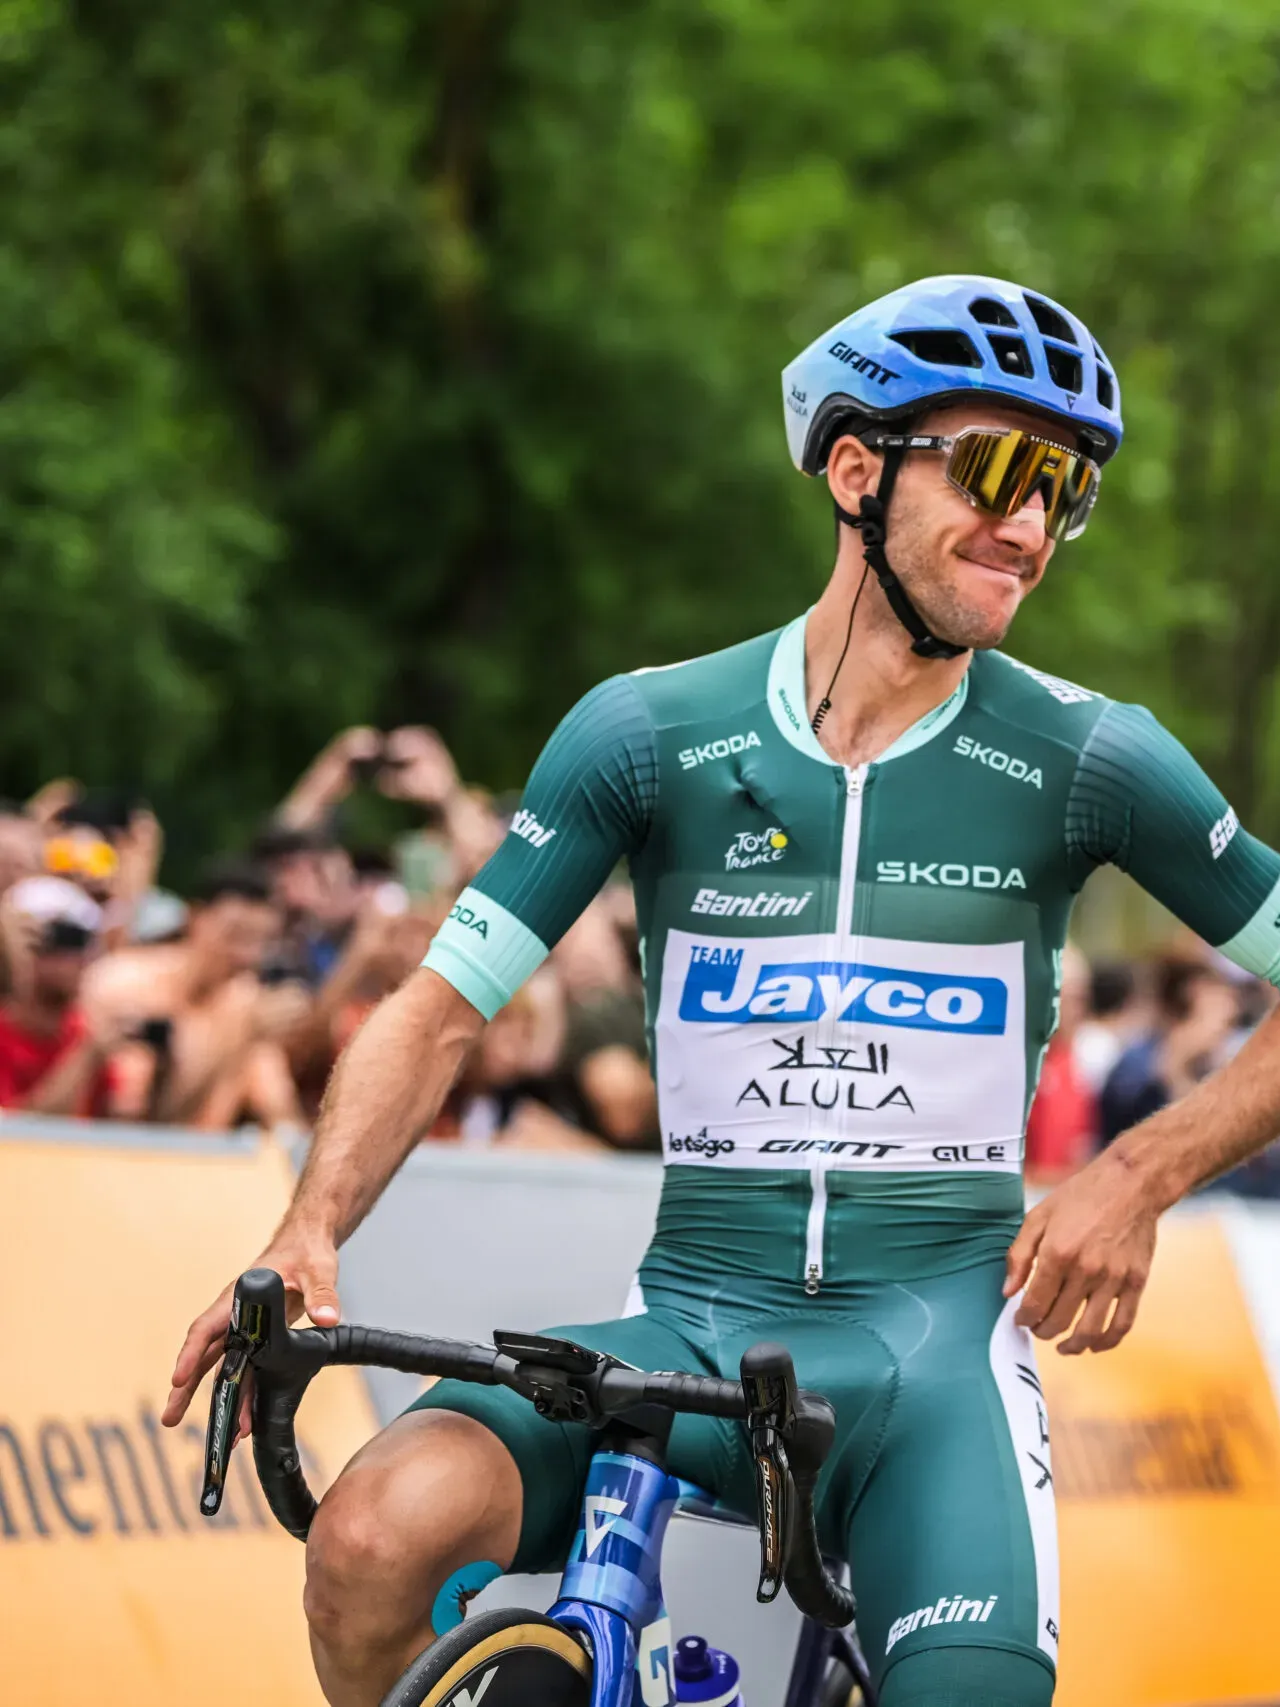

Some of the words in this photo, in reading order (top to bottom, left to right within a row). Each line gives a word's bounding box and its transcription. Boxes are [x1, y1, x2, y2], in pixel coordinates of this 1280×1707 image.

[827, 340, 903, 386] GIANT
[690, 888, 813, 917] Santini
[690, 945, 744, 966] TEAM
[700, 961, 984, 1026] Jayco
[735, 1078, 916, 1114] ALULA
[758, 1138, 904, 1159] GIANT
[885, 1594, 999, 1656] Santini
